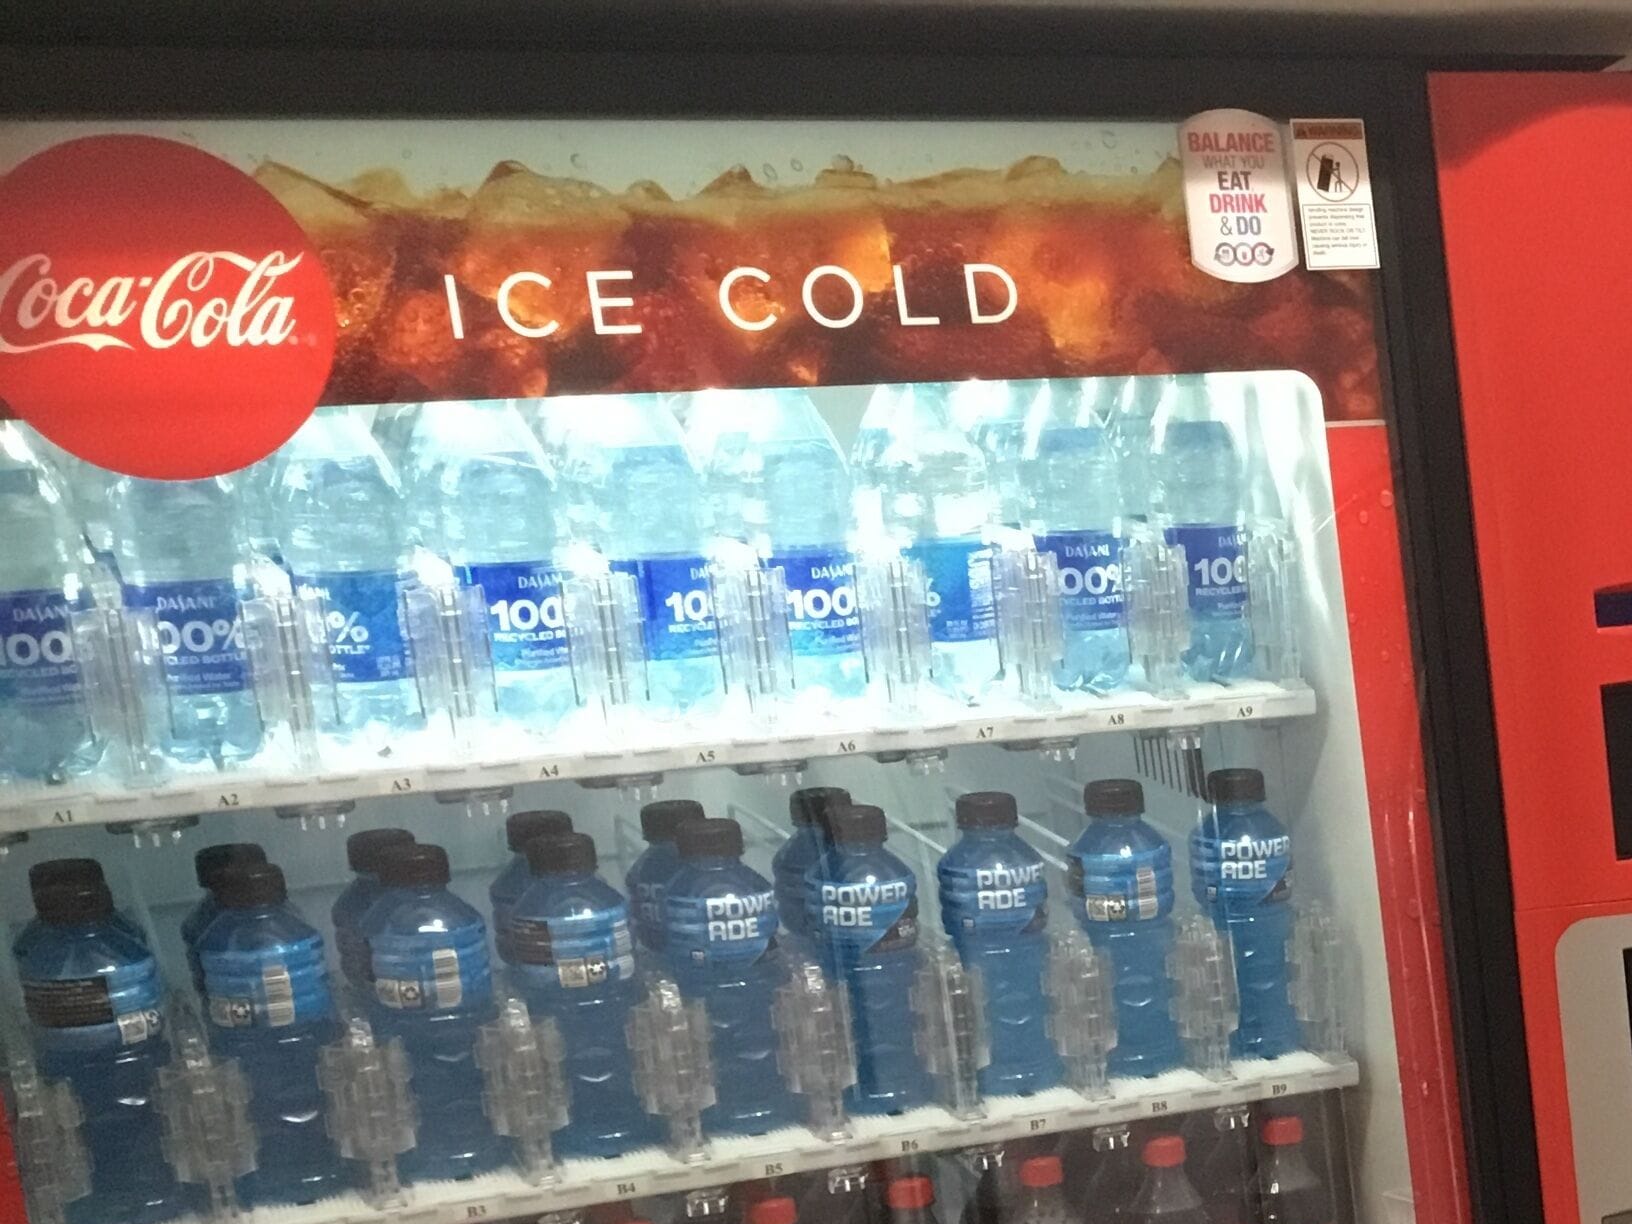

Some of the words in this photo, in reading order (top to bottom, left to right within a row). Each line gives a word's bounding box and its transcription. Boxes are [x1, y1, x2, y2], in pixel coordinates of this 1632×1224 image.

[1187, 131, 1275, 153] BALANCE
[1202, 155, 1237, 169] WHAT
[1241, 154, 1265, 168] YOU
[1217, 171, 1251, 190] EAT
[1209, 193, 1268, 213] DRINK
[1220, 216, 1233, 236] &
[1236, 216, 1261, 235] DO
[0, 249, 304, 353] Coca-Cola
[444, 269, 642, 340] ICE
[719, 263, 1018, 331] COLD
[1107, 713, 1125, 726] A8
[1236, 706, 1253, 719] A9
[976, 726, 994, 740] A7
[836, 739, 857, 753] A6
[695, 749, 716, 763] A5
[538, 764, 560, 779] A4
[391, 777, 412, 792] A3
[217, 794, 240, 808] A2
[51, 810, 73, 824] A1
[1221, 835, 1290, 860] POWER
[1221, 860, 1268, 880] ADE
[821, 881, 908, 906] POWER
[978, 887, 1027, 910] ADE
[822, 904, 874, 927] ADE
[708, 917, 760, 941] ADE
[1271, 1084, 1288, 1096] B9
[1151, 1101, 1168, 1113] B8
[1029, 1120, 1047, 1131] B7
[900, 1140, 919, 1152] B6
[765, 1162, 783, 1176] B5
[616, 1183, 637, 1195] B4
[467, 1205, 487, 1219] B3
